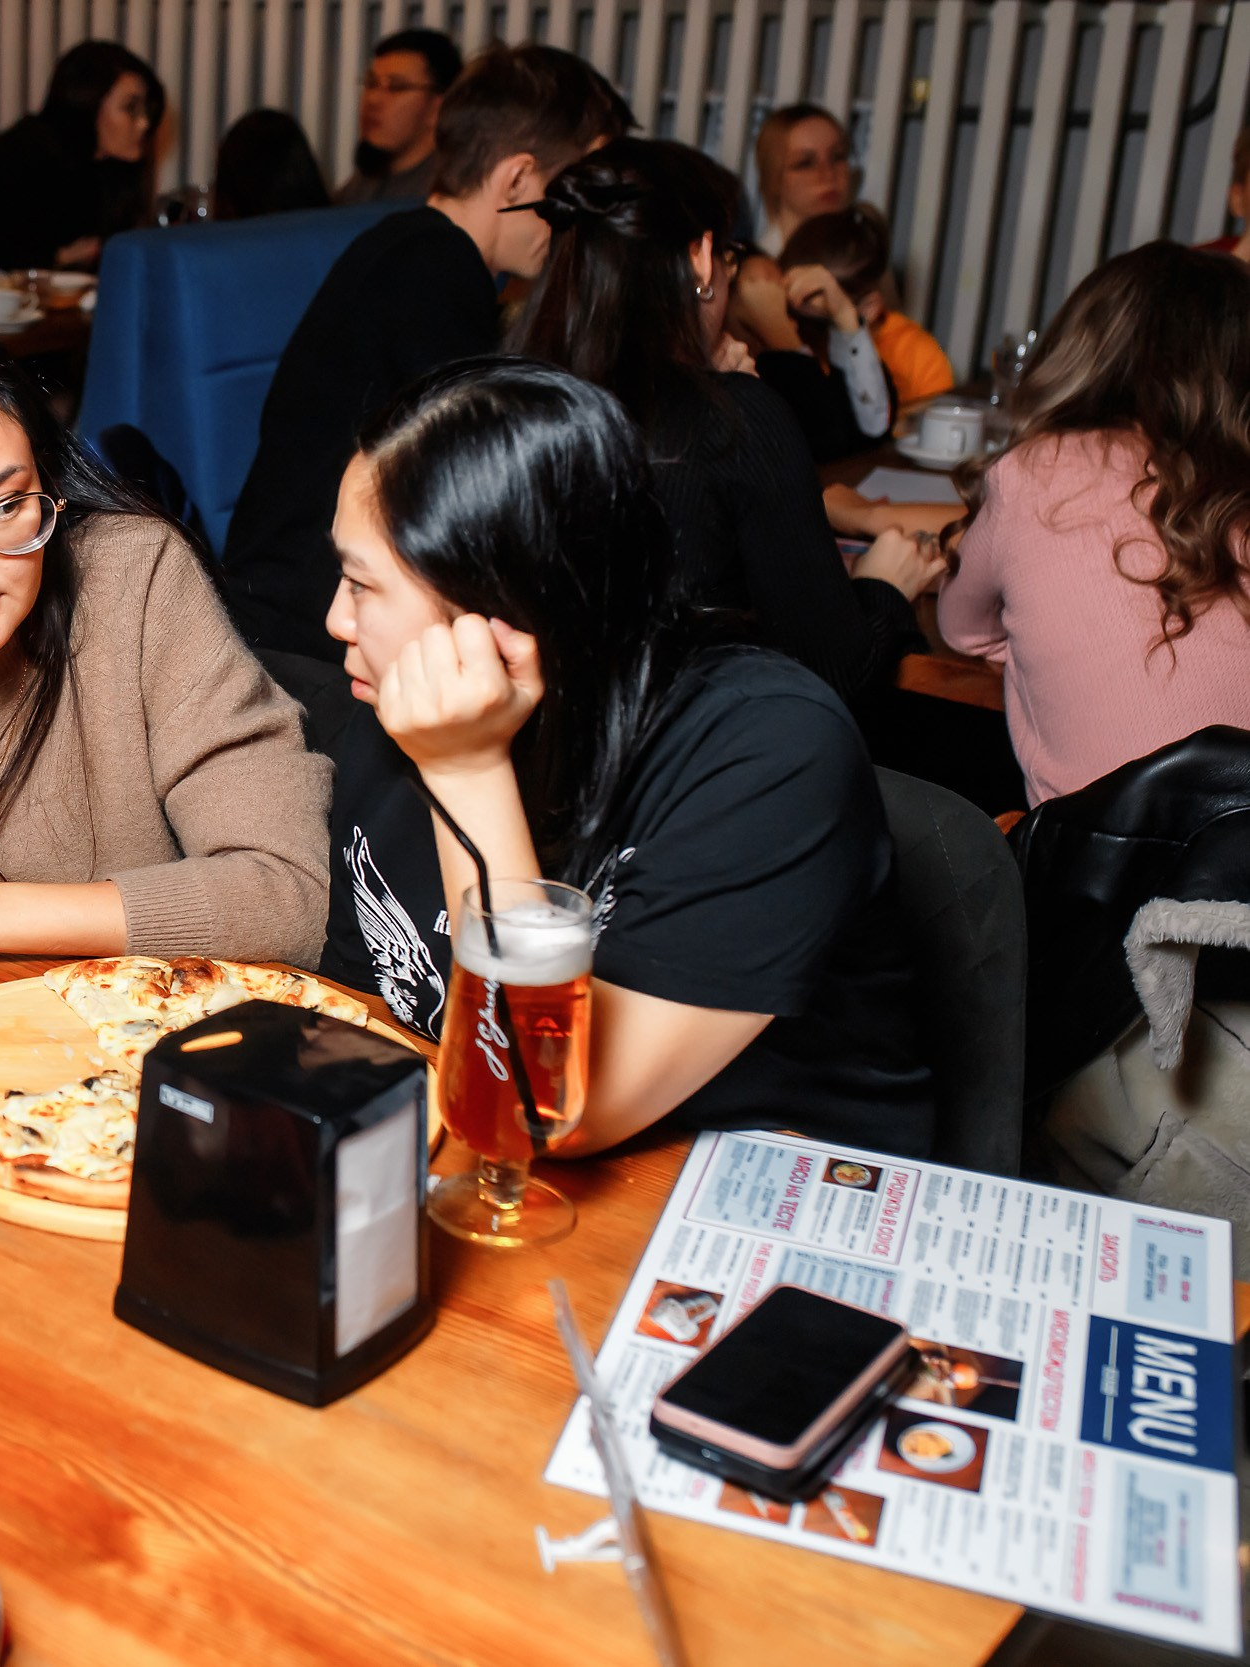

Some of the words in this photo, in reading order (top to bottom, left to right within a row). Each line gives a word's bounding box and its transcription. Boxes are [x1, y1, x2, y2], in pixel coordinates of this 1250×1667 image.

[788, 1155, 813, 1185] МЯСО
[784, 1184, 805, 1199] НА
[882, 1171, 910, 1219] ПРОДУКТЫ
[772, 1200, 799, 1232] ТЕСТЕ
[879, 1217, 897, 1226] В
[872, 1226, 895, 1257] СОУСЕ
[1127, 1332, 1199, 1457] MENU
